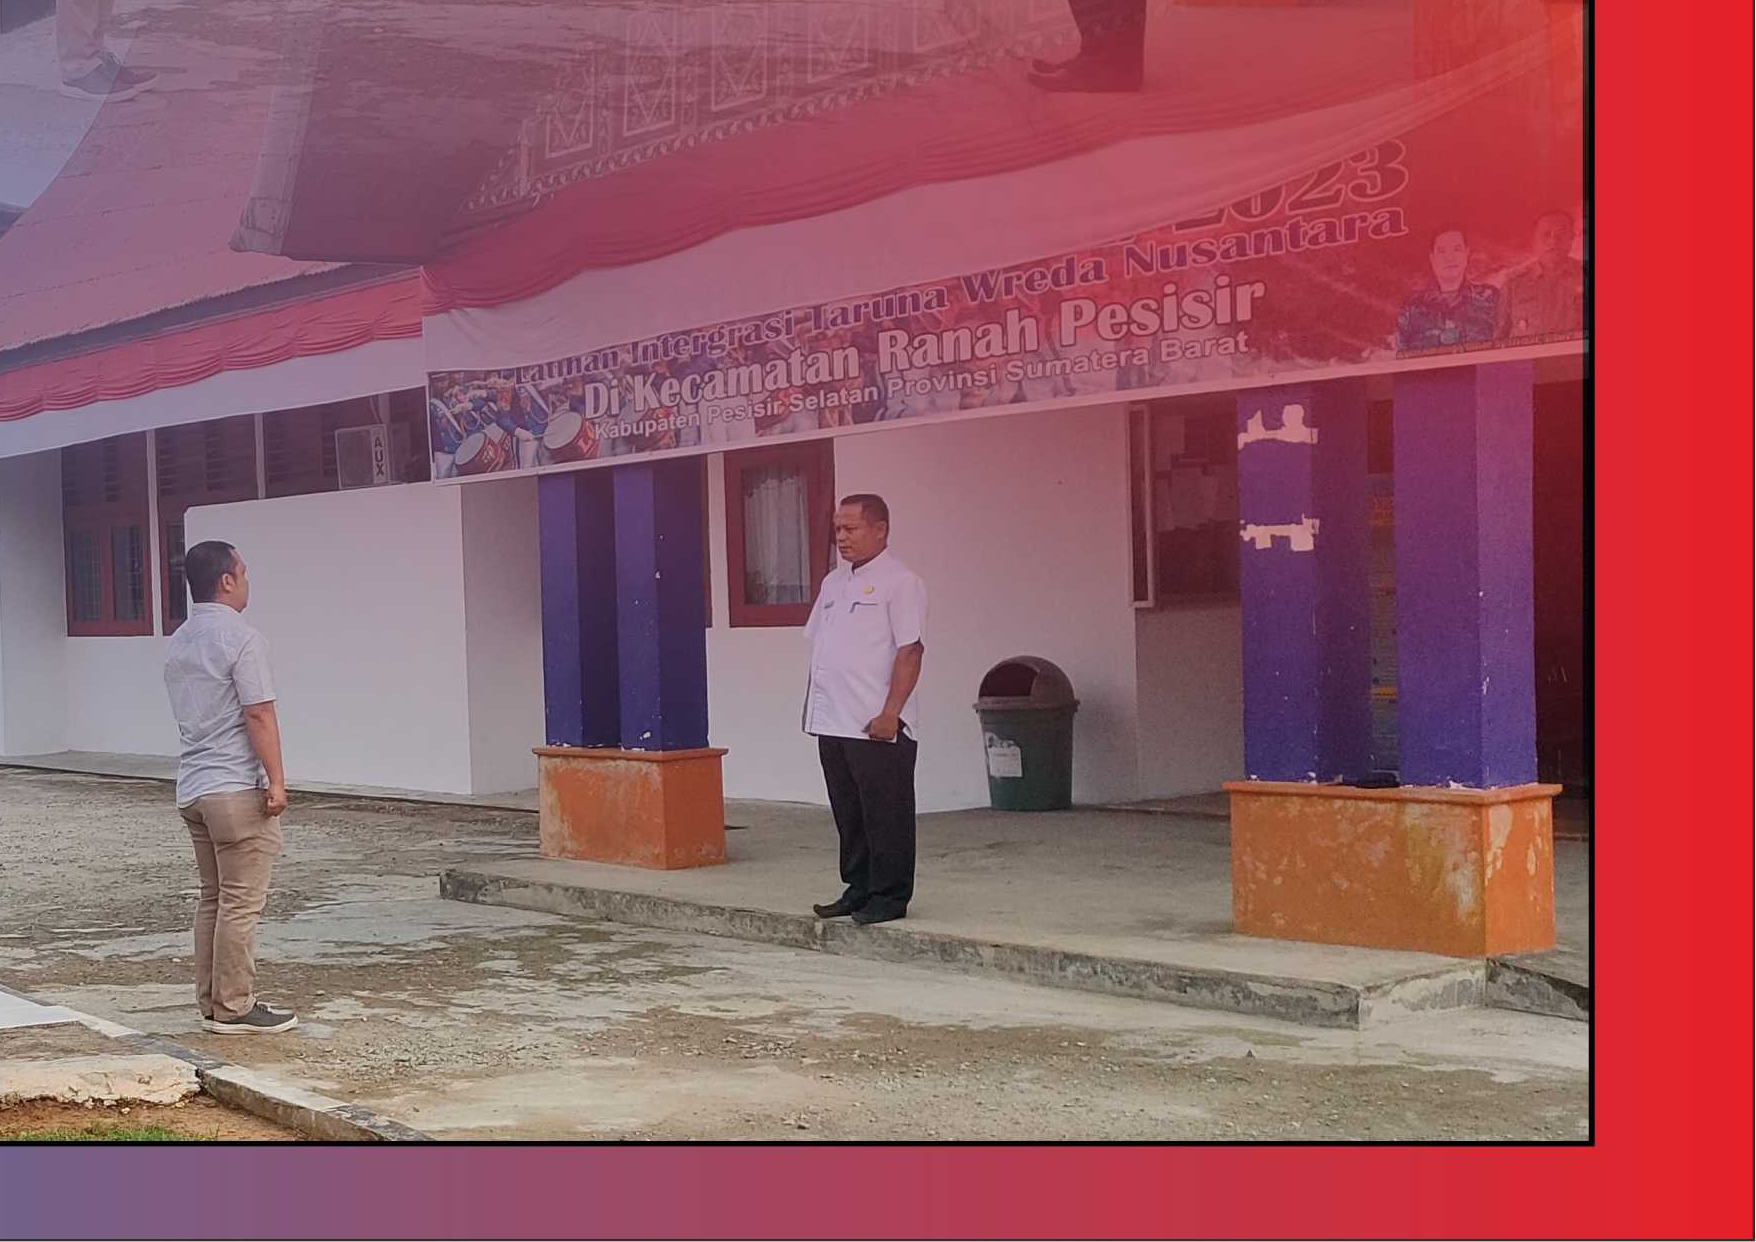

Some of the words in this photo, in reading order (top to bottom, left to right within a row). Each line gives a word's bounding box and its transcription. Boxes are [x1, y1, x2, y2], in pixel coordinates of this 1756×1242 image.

[584, 374, 621, 421] Di
[632, 340, 861, 413] Kecamatan
[877, 308, 1040, 375] Ranah
[1059, 274, 1266, 348] Pesisir
[629, 308, 797, 365] Intergrasi
[808, 286, 950, 333] Taruna
[960, 256, 1109, 305] Wreda
[1123, 205, 1409, 279] Nusantara
[594, 410, 701, 441] Kabupaten
[705, 393, 784, 426] Pesisir
[788, 383, 879, 412] Selatan
[886, 366, 998, 400] Provinsi
[1004, 345, 1150, 382] Sumatera
[1159, 331, 1250, 362] Barat
[374, 436, 385, 477] AUX
